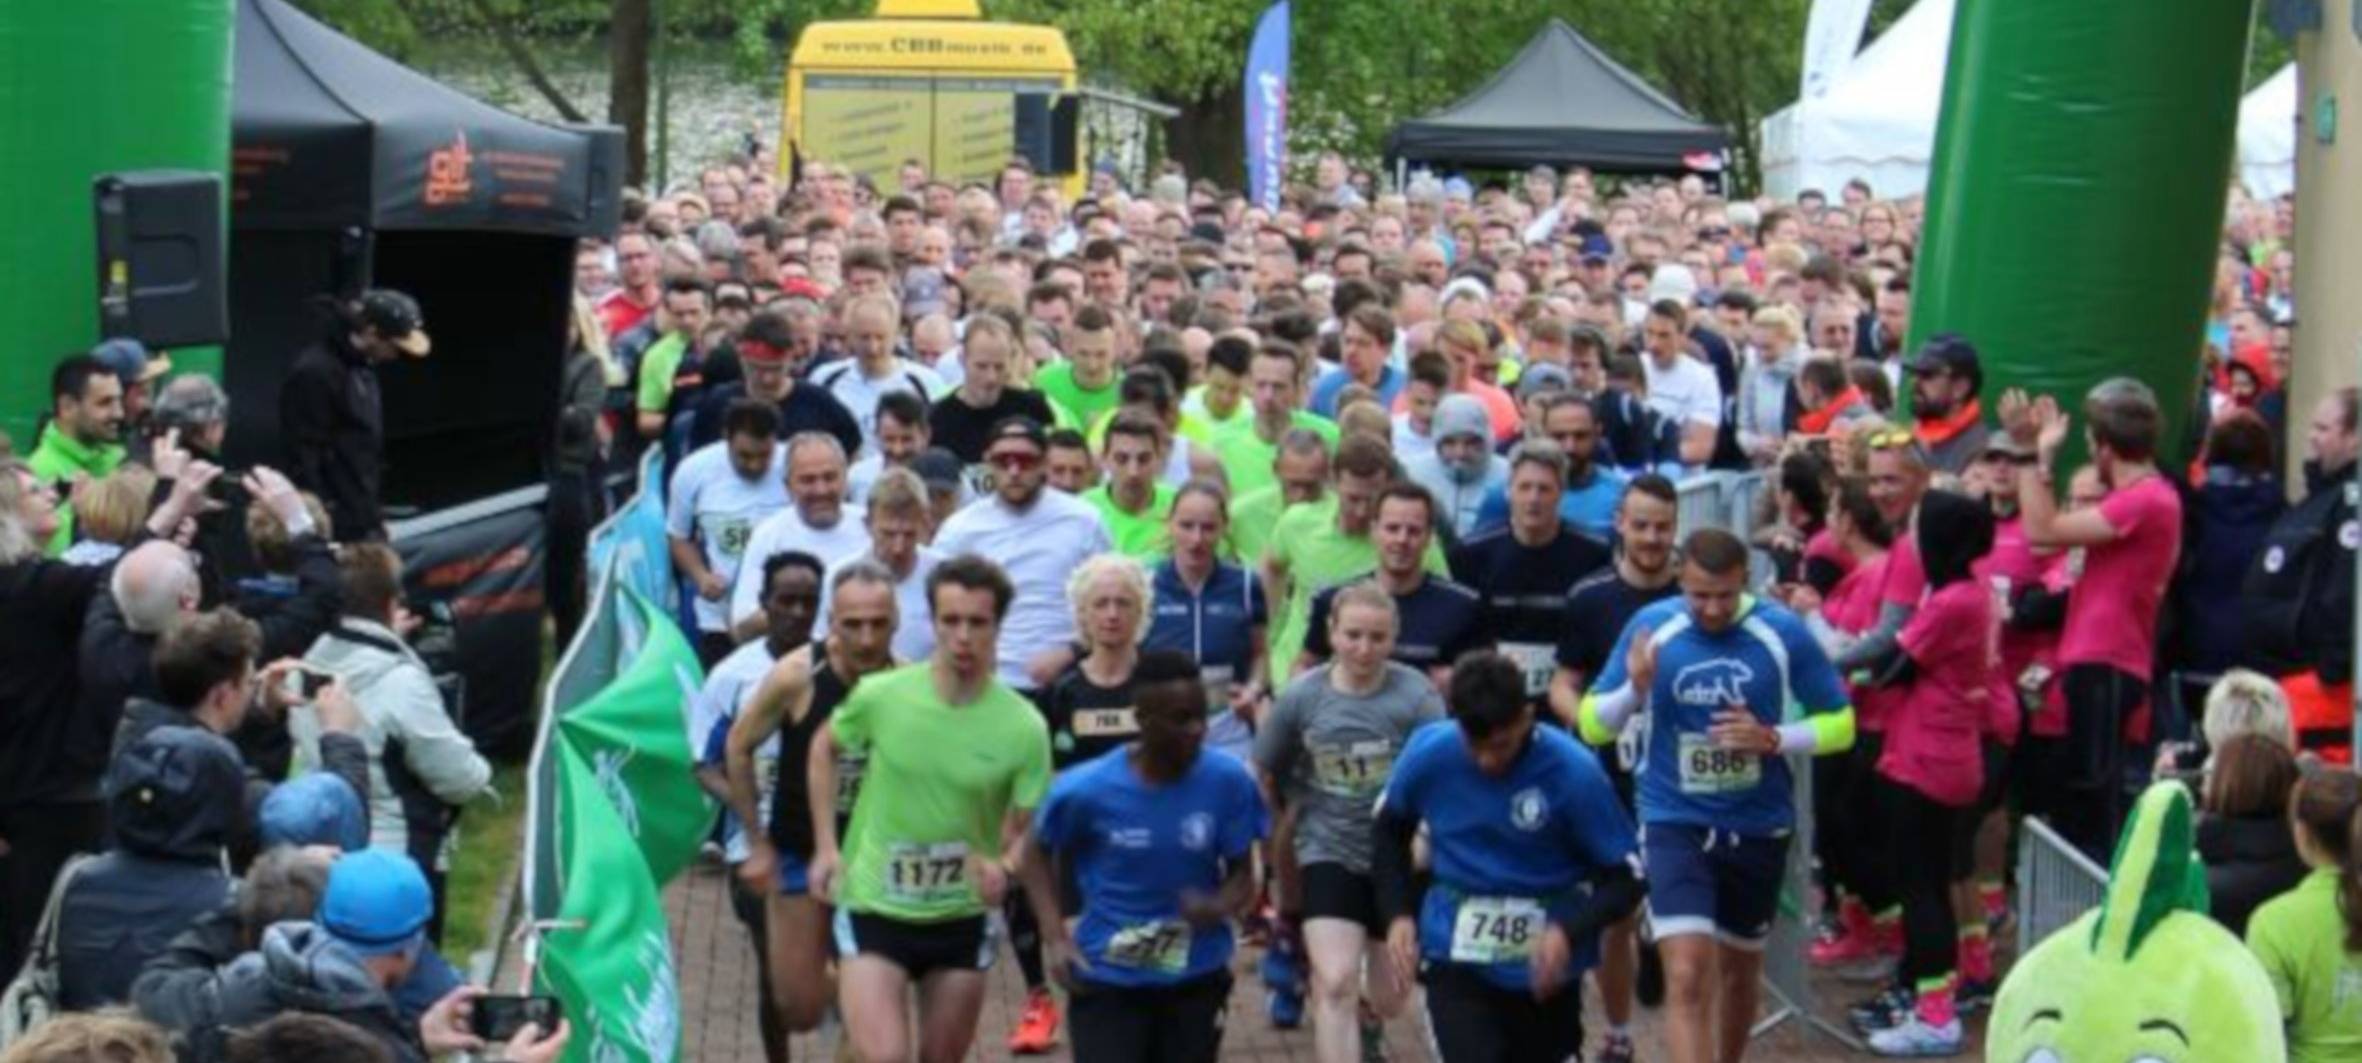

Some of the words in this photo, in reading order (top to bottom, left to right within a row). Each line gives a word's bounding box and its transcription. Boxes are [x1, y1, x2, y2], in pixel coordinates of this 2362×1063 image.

[1692, 748, 1745, 774] 686
[891, 857, 964, 889] 1172
[1471, 911, 1529, 946] 748
